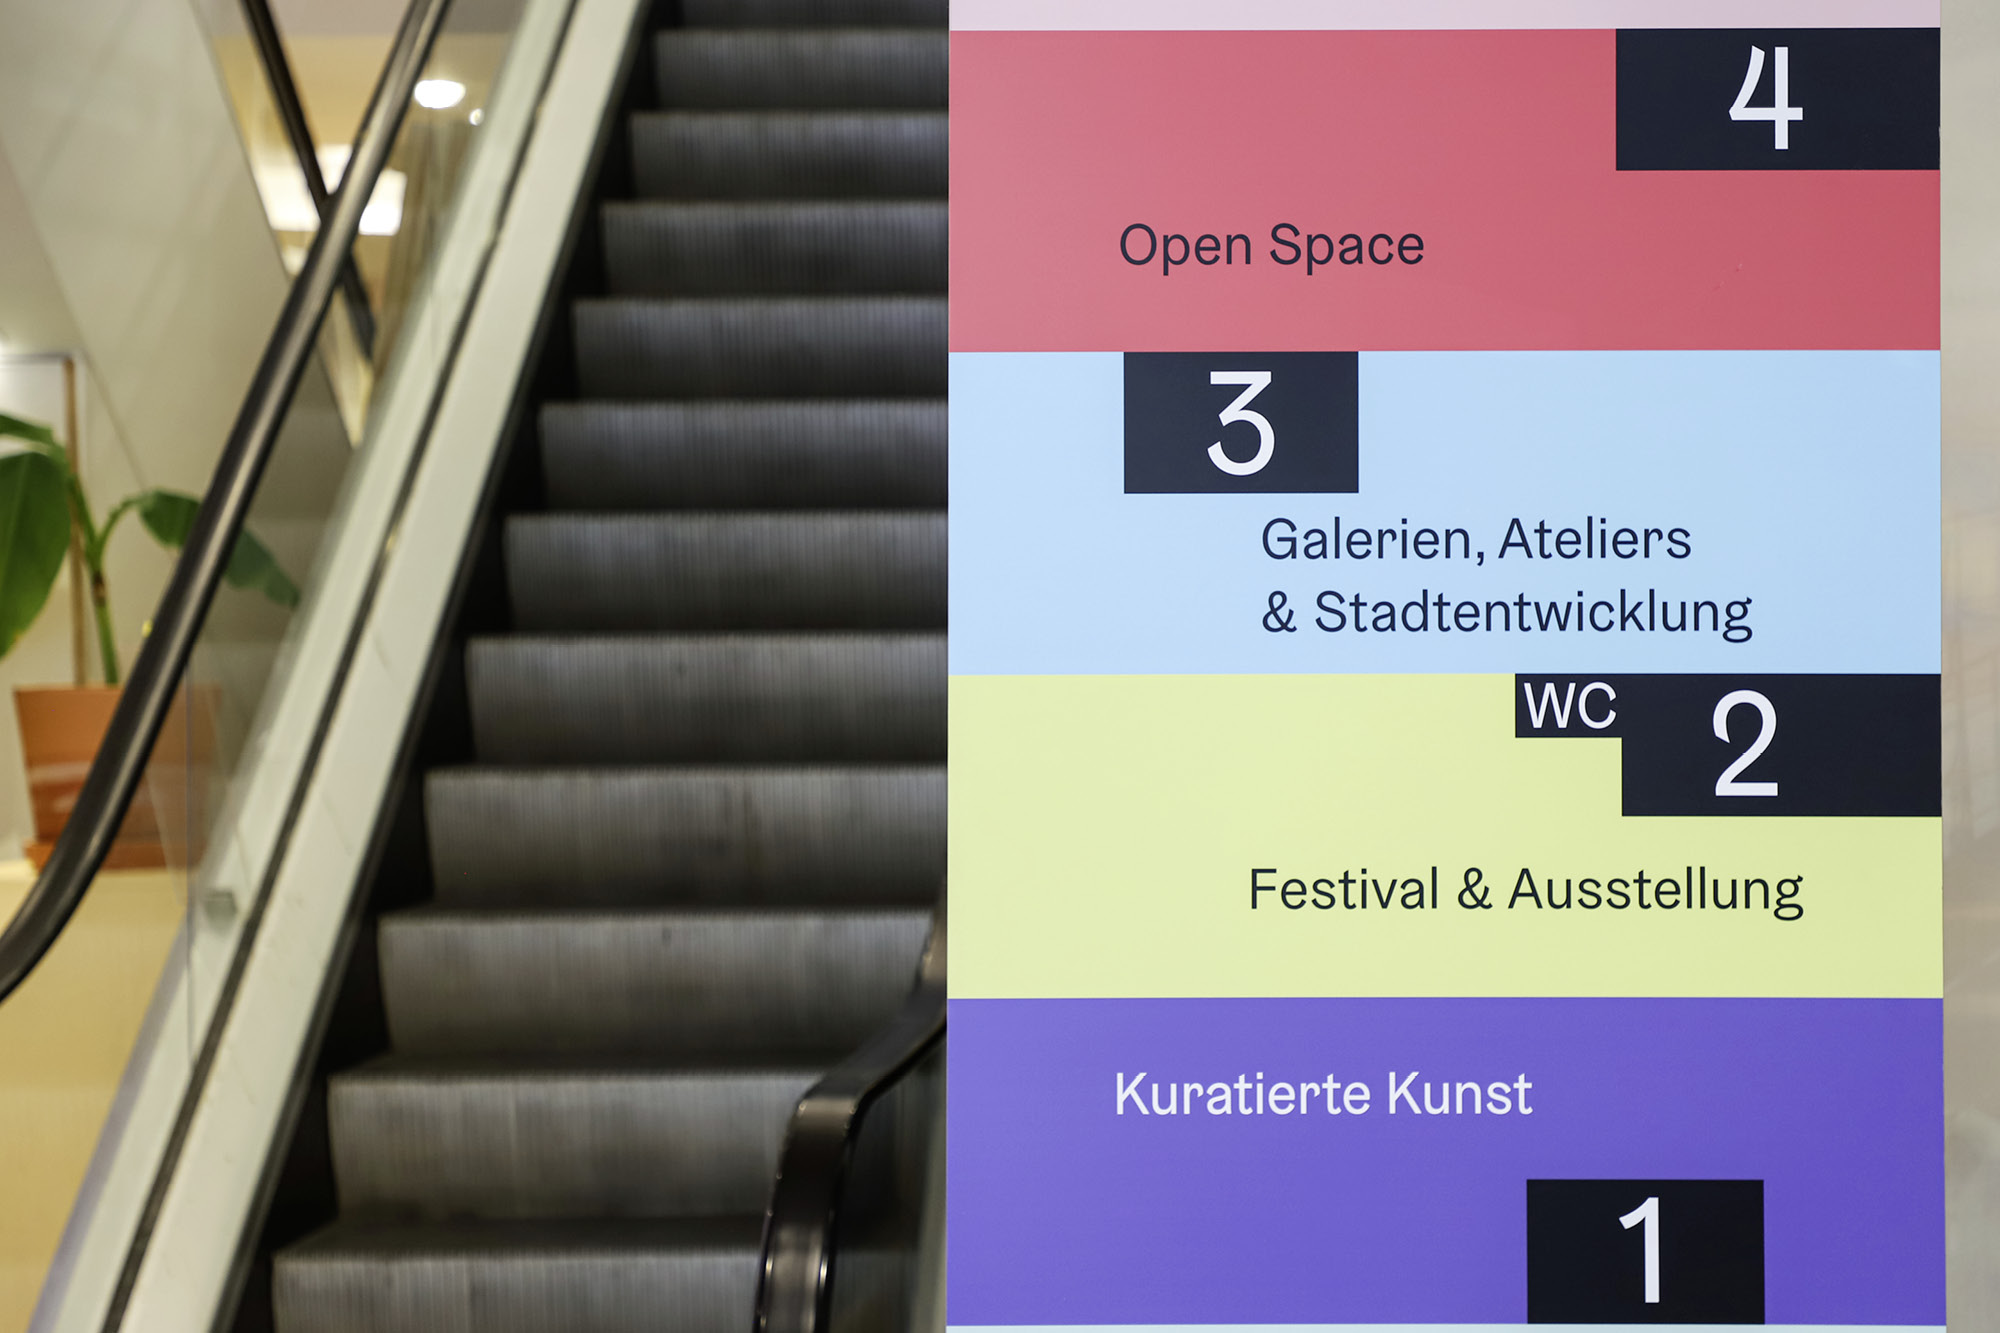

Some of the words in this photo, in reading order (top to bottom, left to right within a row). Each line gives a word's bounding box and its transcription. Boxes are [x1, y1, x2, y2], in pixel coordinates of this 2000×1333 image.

[1728, 45, 1804, 150] 4
[1119, 223, 1251, 277] Open
[1269, 222, 1424, 276] Space
[1207, 370, 1275, 476] 3
[1262, 516, 1485, 567] Galerien,
[1498, 515, 1692, 560] Ateliers
[1262, 590, 1298, 633] &
[1315, 588, 1753, 644] Stadtentwicklung
[1523, 681, 1618, 730] WC
[1712, 689, 1780, 797] 2
[1251, 866, 1438, 911] Festival
[1457, 867, 1493, 911] &
[1507, 866, 1804, 922] Ausstellung
[1116, 1071, 1371, 1116] Kuratierte
[1388, 1071, 1533, 1116] Kunst
[1618, 1196, 1660, 1304] 1
